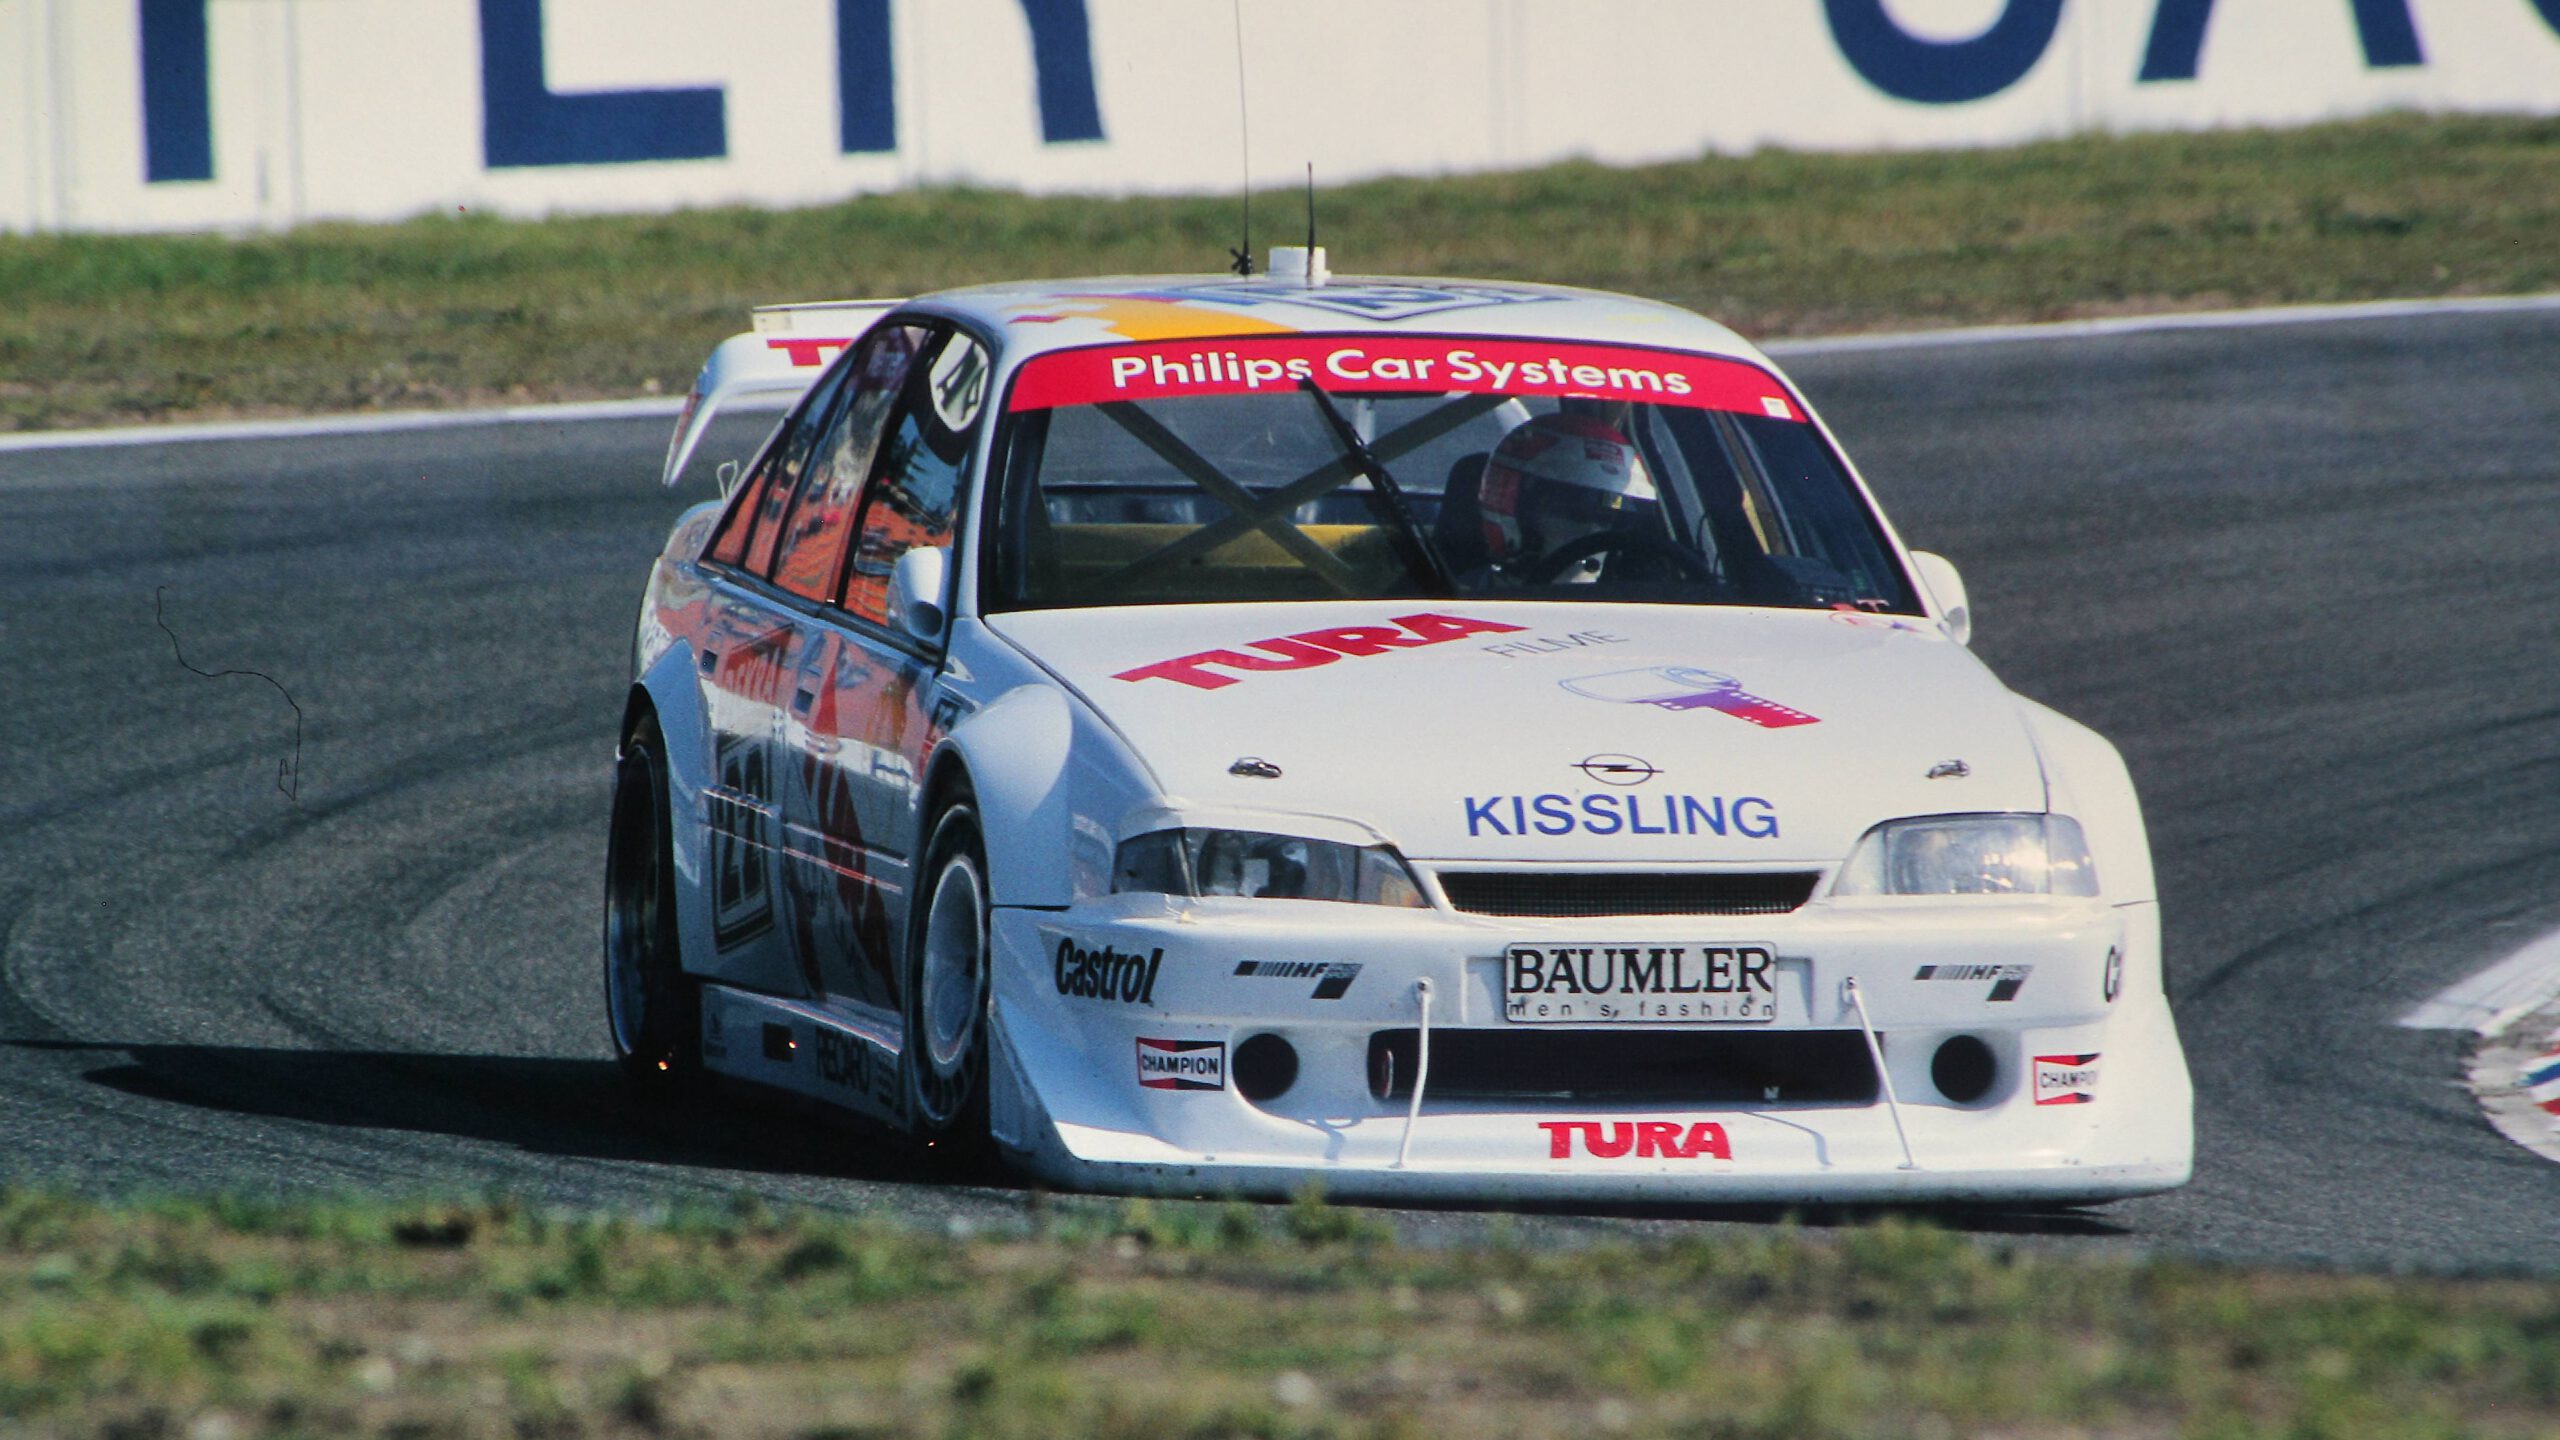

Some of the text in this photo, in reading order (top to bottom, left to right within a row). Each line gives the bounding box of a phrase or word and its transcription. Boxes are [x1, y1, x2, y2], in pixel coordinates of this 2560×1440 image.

[1110, 348, 1692, 395] Philips Car Systems
[1109, 612, 1531, 691] TURA
[1480, 630, 1631, 658] FILME
[1464, 793, 1780, 839] KISSLING
[1055, 936, 1165, 1006] Castrol
[1509, 947, 1773, 994] BÄUMLER
[1639, 1000, 1775, 1018] fashion
[1141, 1053, 1219, 1075] CHAMPION
[1537, 1121, 1734, 1160] TURA
